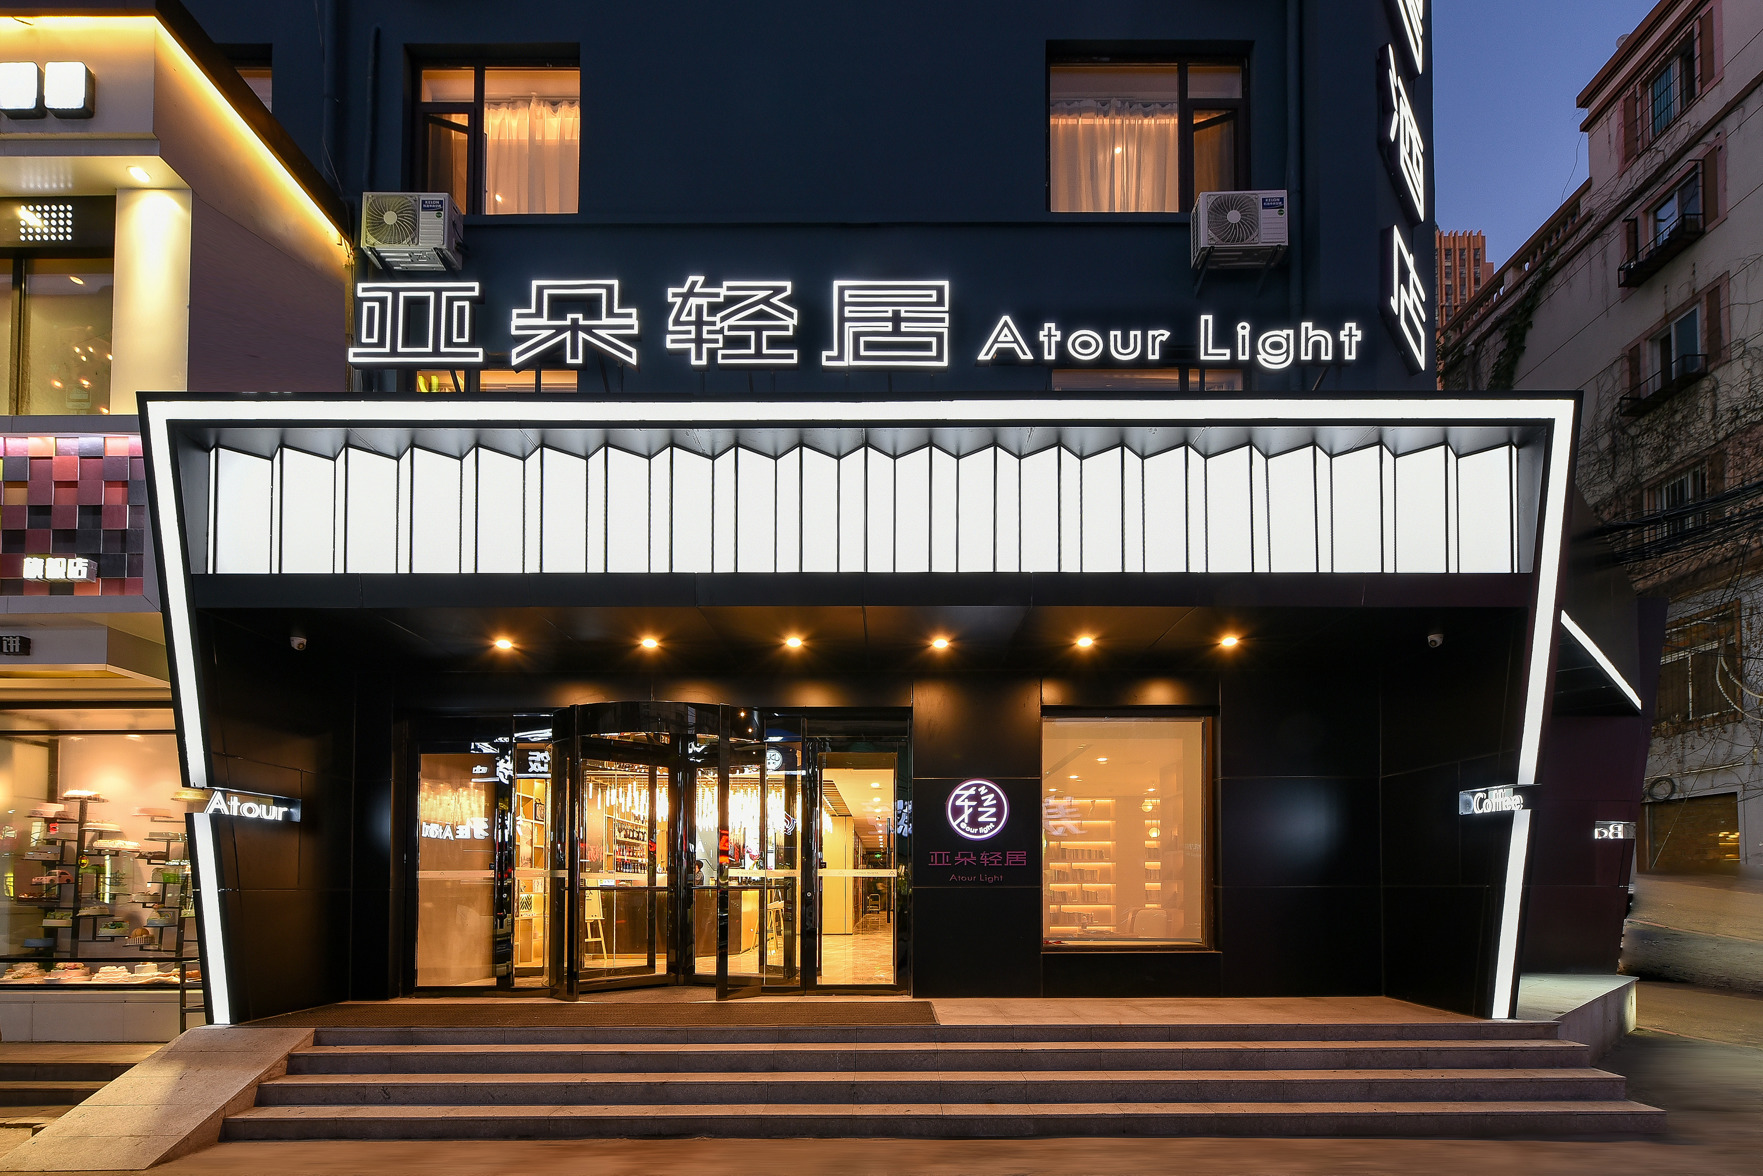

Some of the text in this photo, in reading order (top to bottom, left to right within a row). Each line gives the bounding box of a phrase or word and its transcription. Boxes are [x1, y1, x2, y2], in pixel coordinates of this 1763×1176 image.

[348, 276, 949, 366] 亚朵轻居
[977, 314, 1362, 370] Atour Light
[204, 790, 289, 821] Atour
[1473, 788, 1523, 814] Coffee
[928, 850, 1027, 867] 亚朵轻居
[949, 873, 1004, 884] Atour Light
